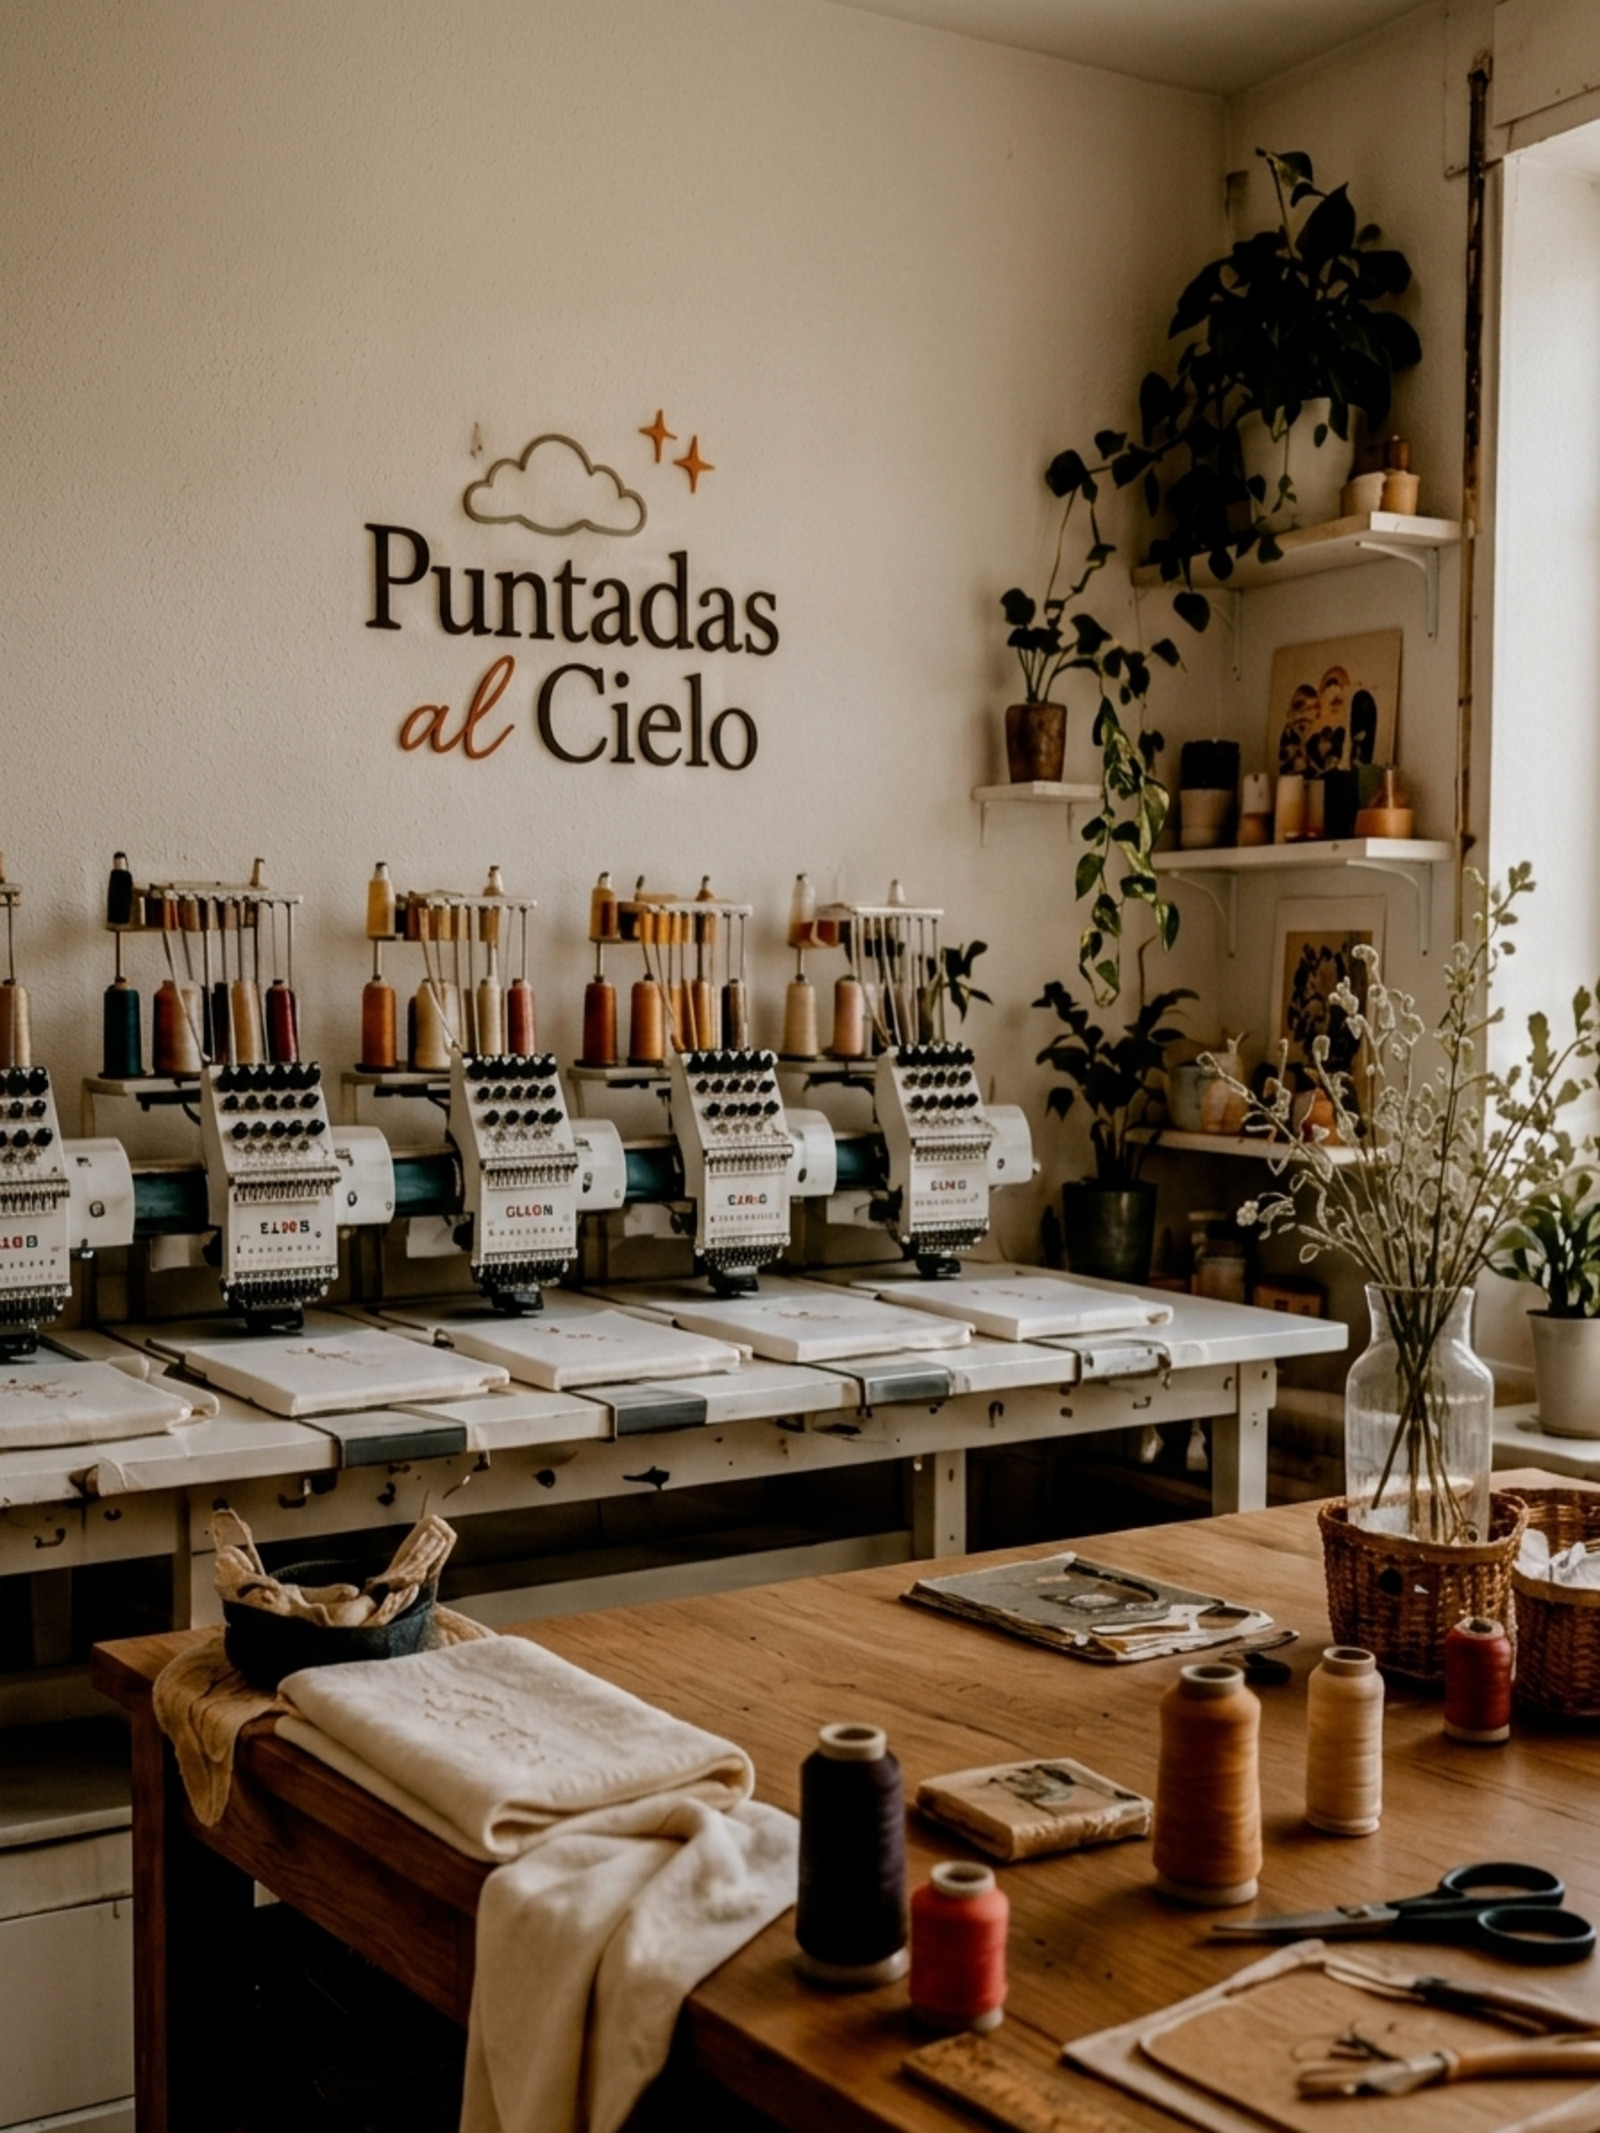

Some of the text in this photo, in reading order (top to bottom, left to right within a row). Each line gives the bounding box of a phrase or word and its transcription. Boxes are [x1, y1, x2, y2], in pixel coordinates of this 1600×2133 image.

[364, 522, 780, 657] Puntadas
[399, 654, 759, 771] al Cielo
